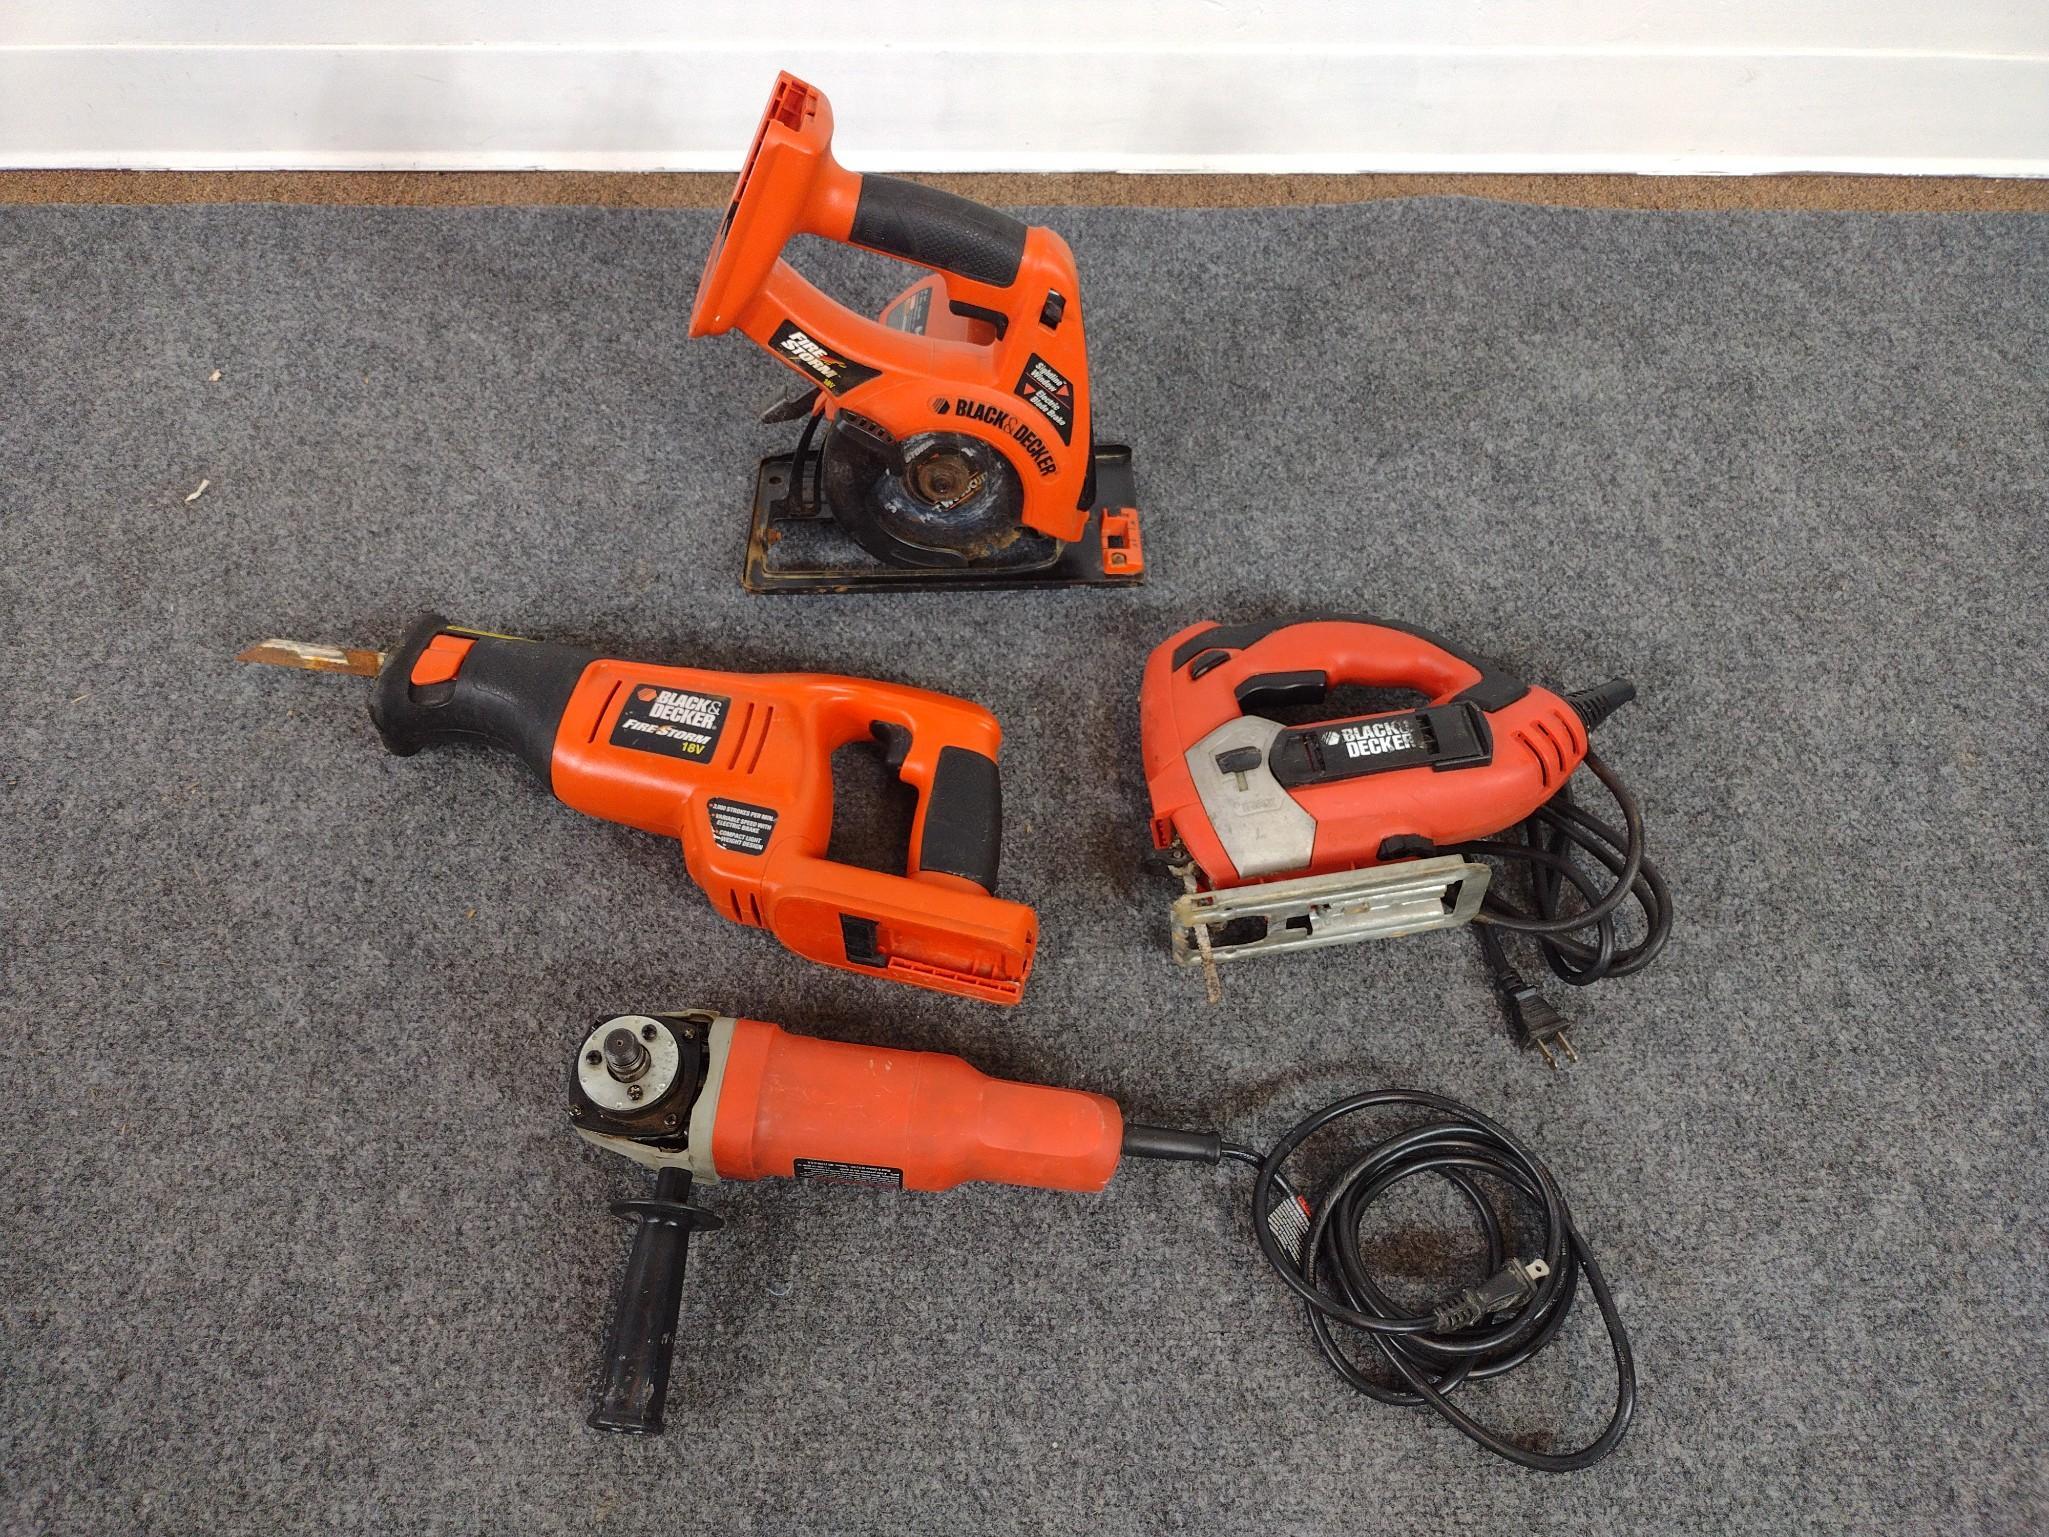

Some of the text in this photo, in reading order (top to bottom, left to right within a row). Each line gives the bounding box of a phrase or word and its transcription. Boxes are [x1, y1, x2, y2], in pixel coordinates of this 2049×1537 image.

[788, 331, 828, 357] FIRE
[780, 339, 839, 378] STORM
[1030, 369, 1057, 392] Window
[1030, 396, 1066, 426] Blade Brake
[1036, 390, 1060, 411] Electric
[649, 703, 716, 729] DECKER
[682, 741, 705, 755] 18V
[1346, 733, 1416, 758] DECKER
[715, 813, 772, 831] VARIABLE SPEED WITH
[726, 806, 751, 816] STROKES
[750, 811, 761, 819] PER
[716, 820, 760, 834] ELECTRIC BRAKE
[719, 830, 762, 844] COMPACT LIGHT
[742, 840, 763, 850] DESIGN
